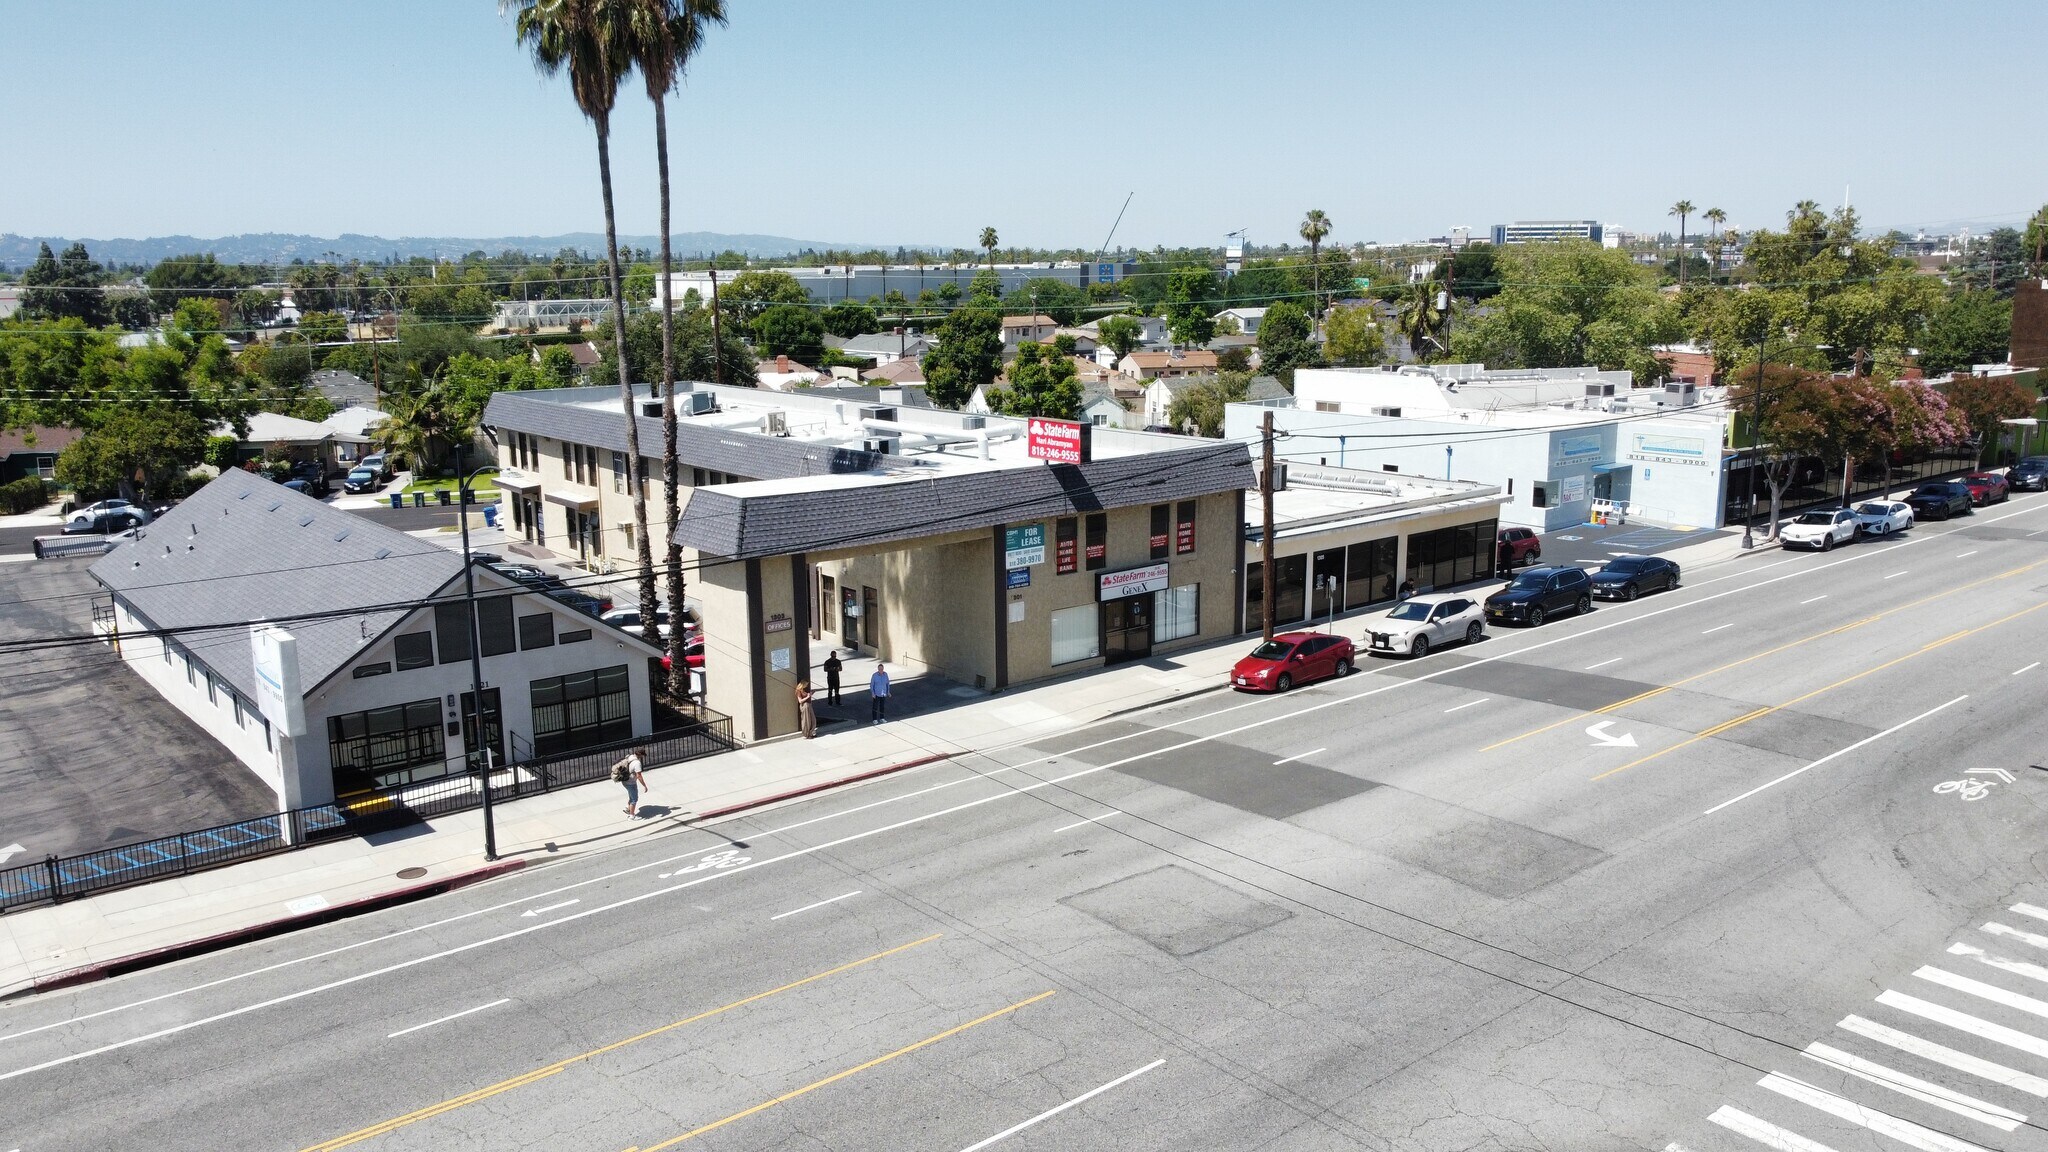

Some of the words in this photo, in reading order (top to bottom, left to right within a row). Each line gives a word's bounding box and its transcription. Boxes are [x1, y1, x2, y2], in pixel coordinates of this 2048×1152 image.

[1031, 445, 1079, 461] 818-246-9555
[1025, 528, 1038, 537] FOR
[1021, 536, 1042, 547] LEASE
[1060, 540, 1073, 548] AUTO
[1060, 564, 1073, 572] BANK
[767, 621, 791, 631] OFFICES
[470, 681, 489, 690] 121
